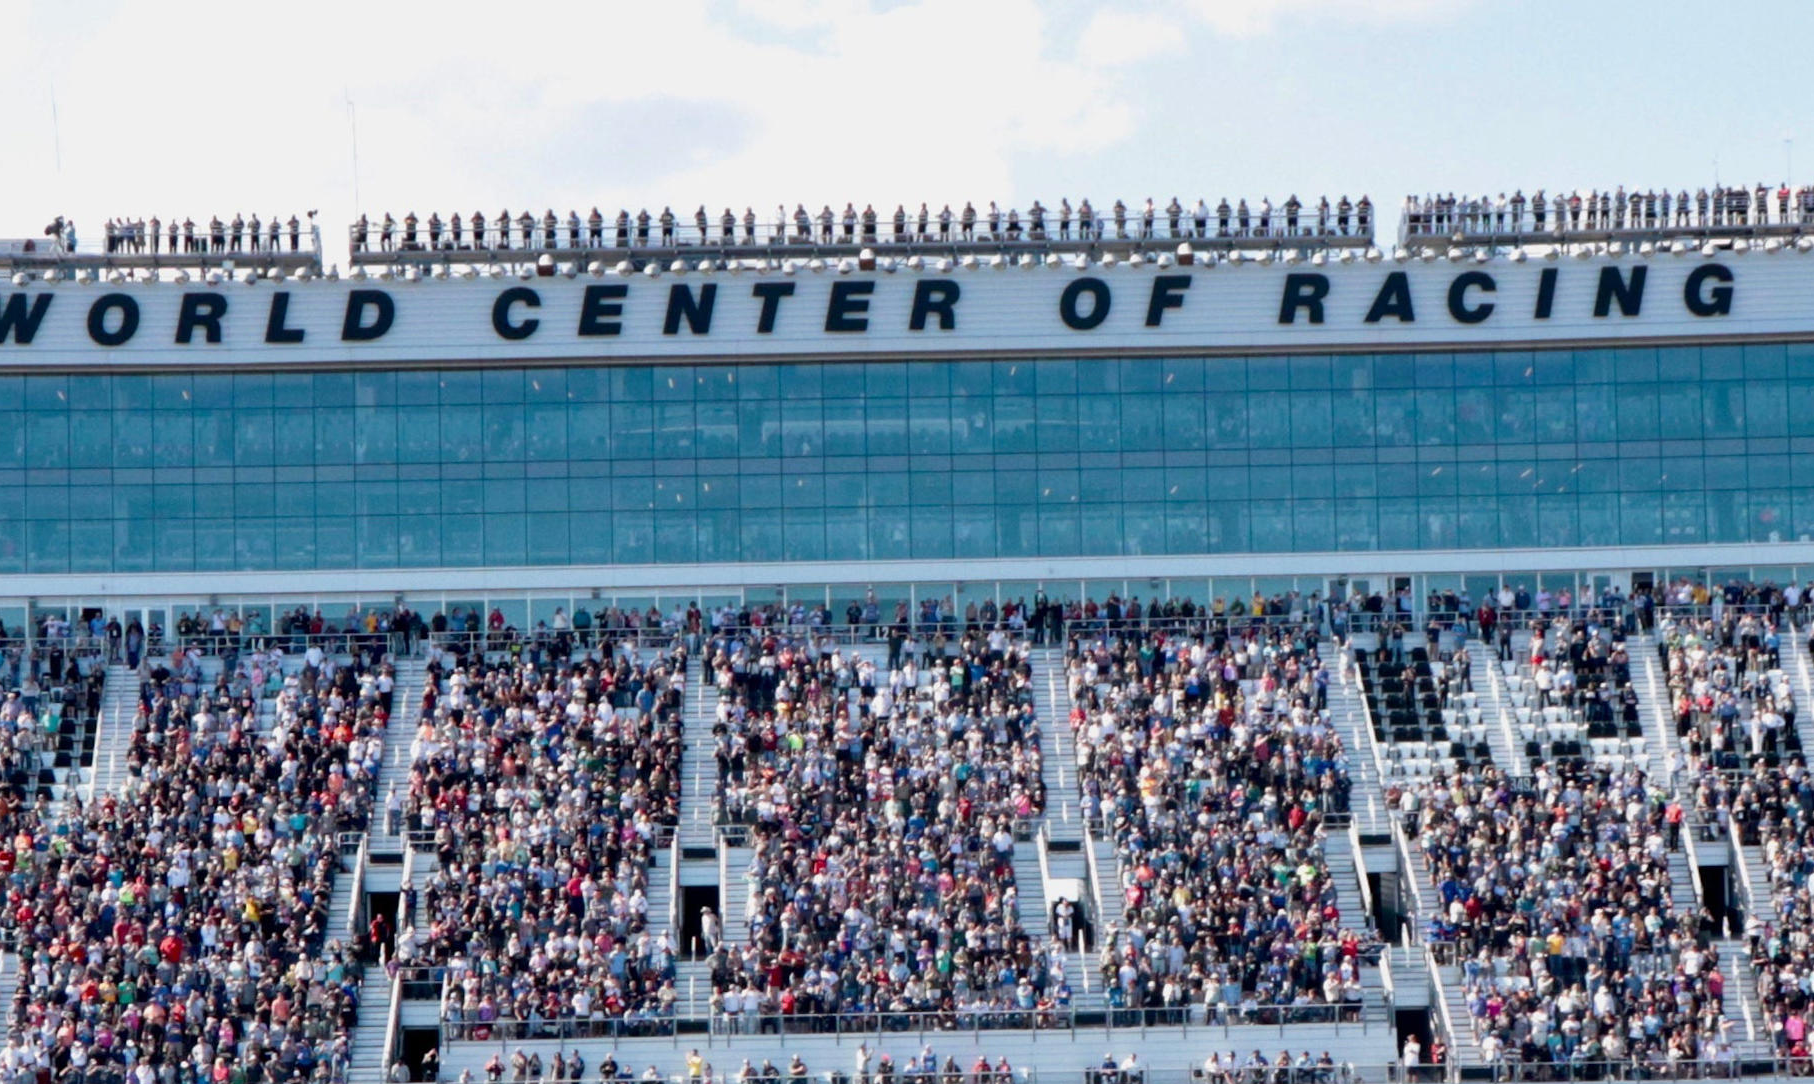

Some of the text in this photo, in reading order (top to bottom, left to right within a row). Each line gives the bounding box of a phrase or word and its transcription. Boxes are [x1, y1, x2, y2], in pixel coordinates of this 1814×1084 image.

[492, 279, 961, 341] CENTER
[1059, 274, 1192, 331] OF
[1278, 263, 1734, 325] RACING
